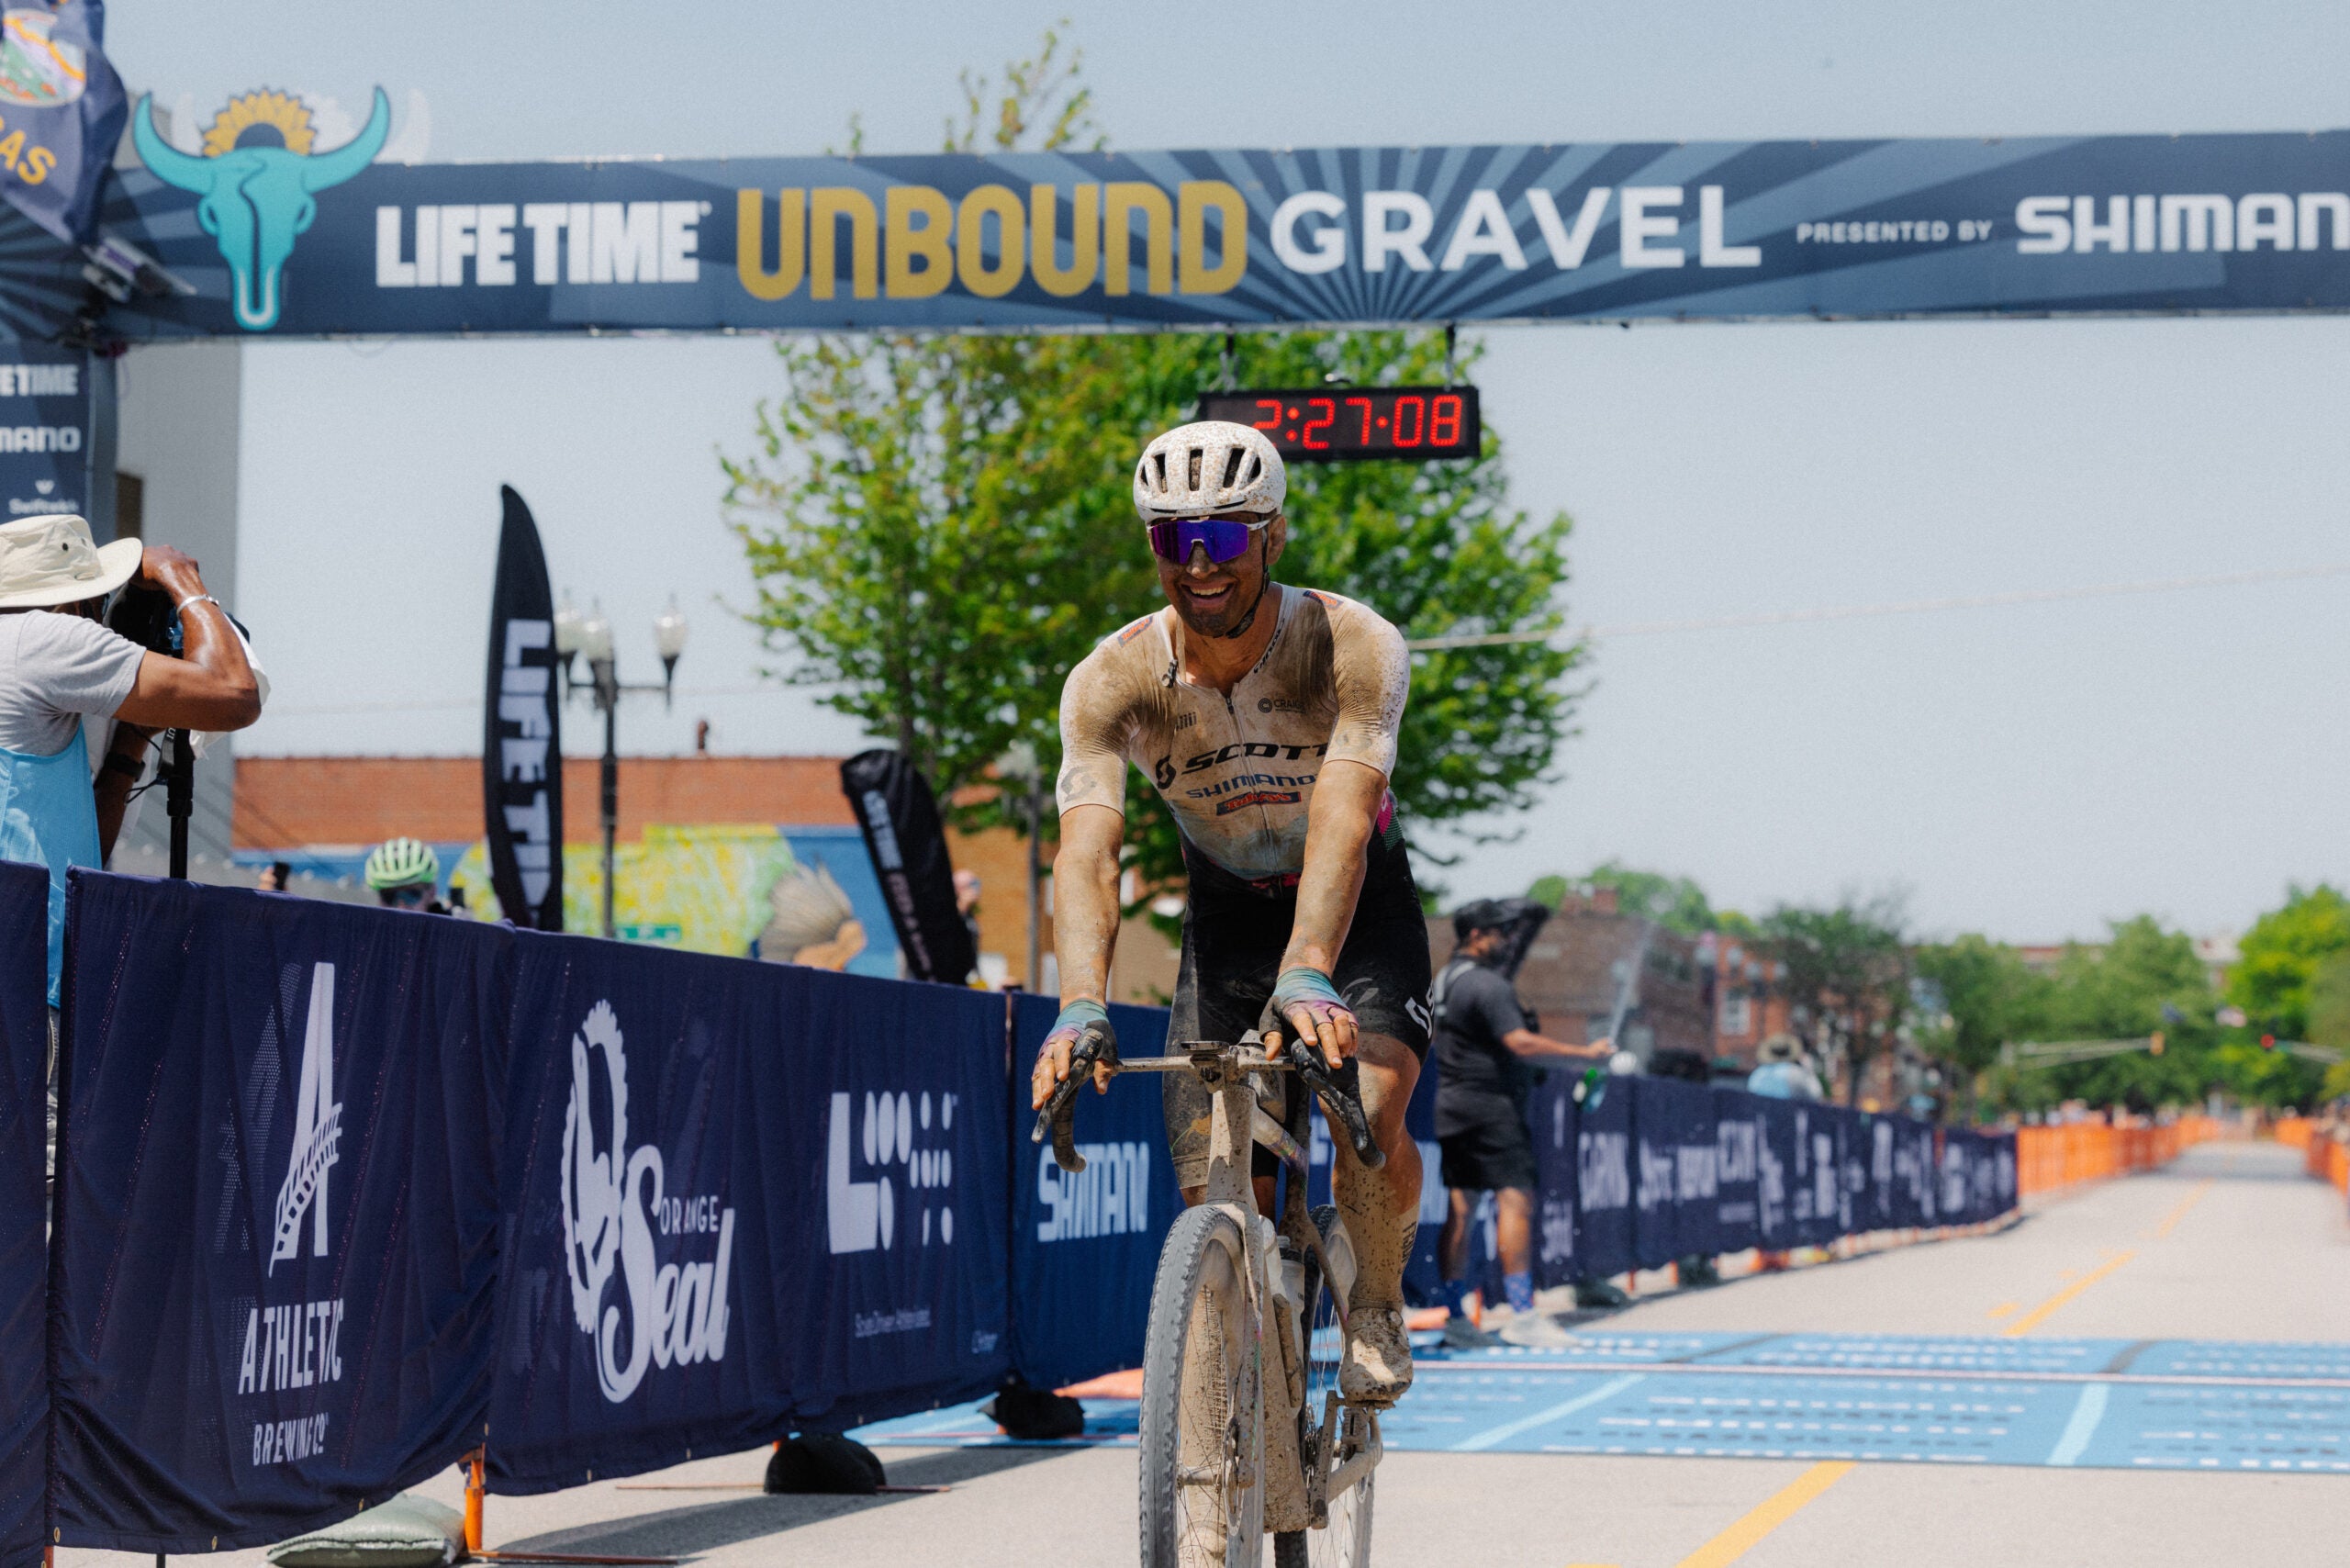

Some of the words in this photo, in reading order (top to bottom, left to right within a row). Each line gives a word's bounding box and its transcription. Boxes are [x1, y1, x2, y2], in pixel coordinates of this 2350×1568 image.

[0, 116, 56, 185] AS
[738, 181, 1248, 299] UNBOUND
[1270, 185, 1762, 274] GRAVEL
[1796, 221, 1948, 244] PRESENTED
[1958, 220, 1993, 241] BY
[1186, 774, 1316, 798] SHIMANO
[660, 1195, 719, 1236] ORANGE
[596, 1145, 734, 1403] Seal
[238, 1298, 344, 1394] ATHLETIC
